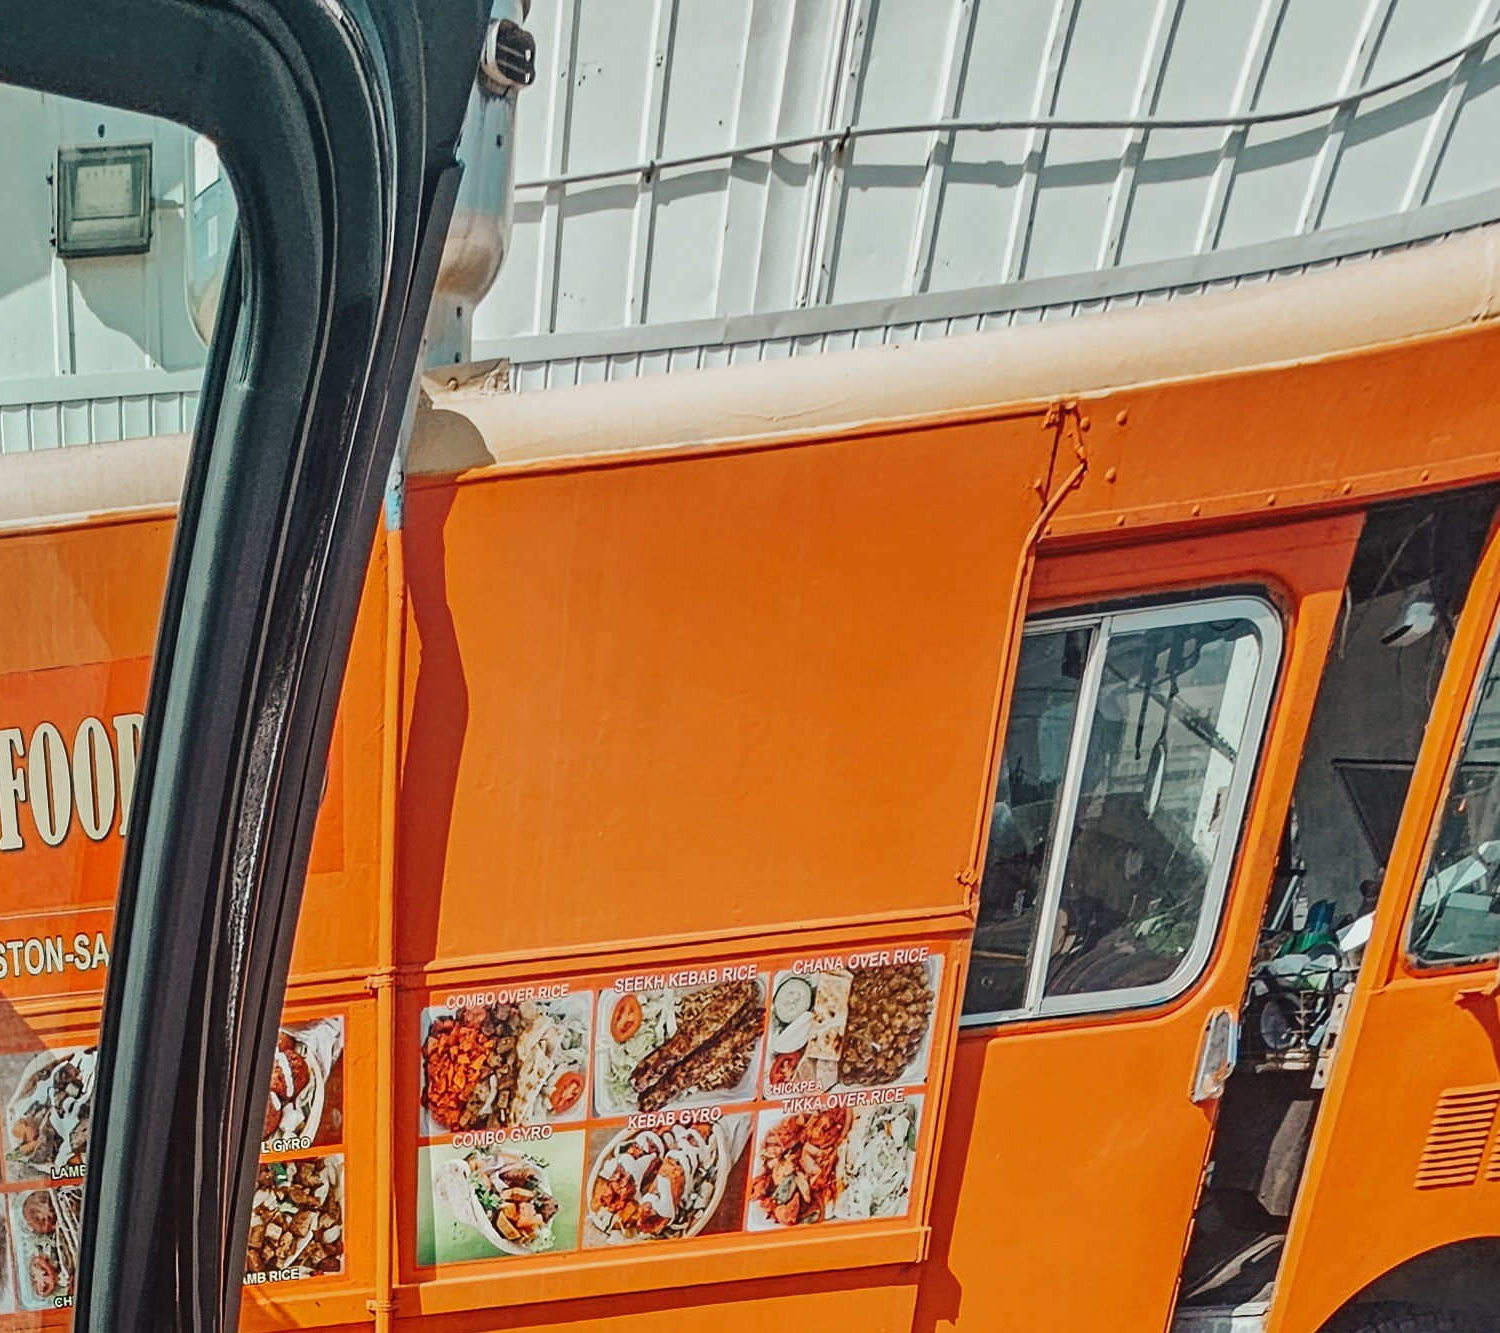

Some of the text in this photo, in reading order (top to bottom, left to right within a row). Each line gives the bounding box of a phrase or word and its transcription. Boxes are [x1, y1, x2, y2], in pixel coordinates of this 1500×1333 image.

[792, 947, 930, 975] CHANA OVER RICE
[615, 965, 757, 993] SEEKH KEBAB RICE
[446, 984, 569, 1009] COMBO OVER RICE
[765, 1080, 823, 1096] CHICKPEA
[782, 1088, 905, 1114] TIKKA OVER RICE
[628, 1107, 722, 1129] KEBAB GYRO
[273, 1137, 311, 1151] GYRO
[453, 1125, 552, 1148] COMBO GYRO
[269, 1269, 300, 1282] RICE
